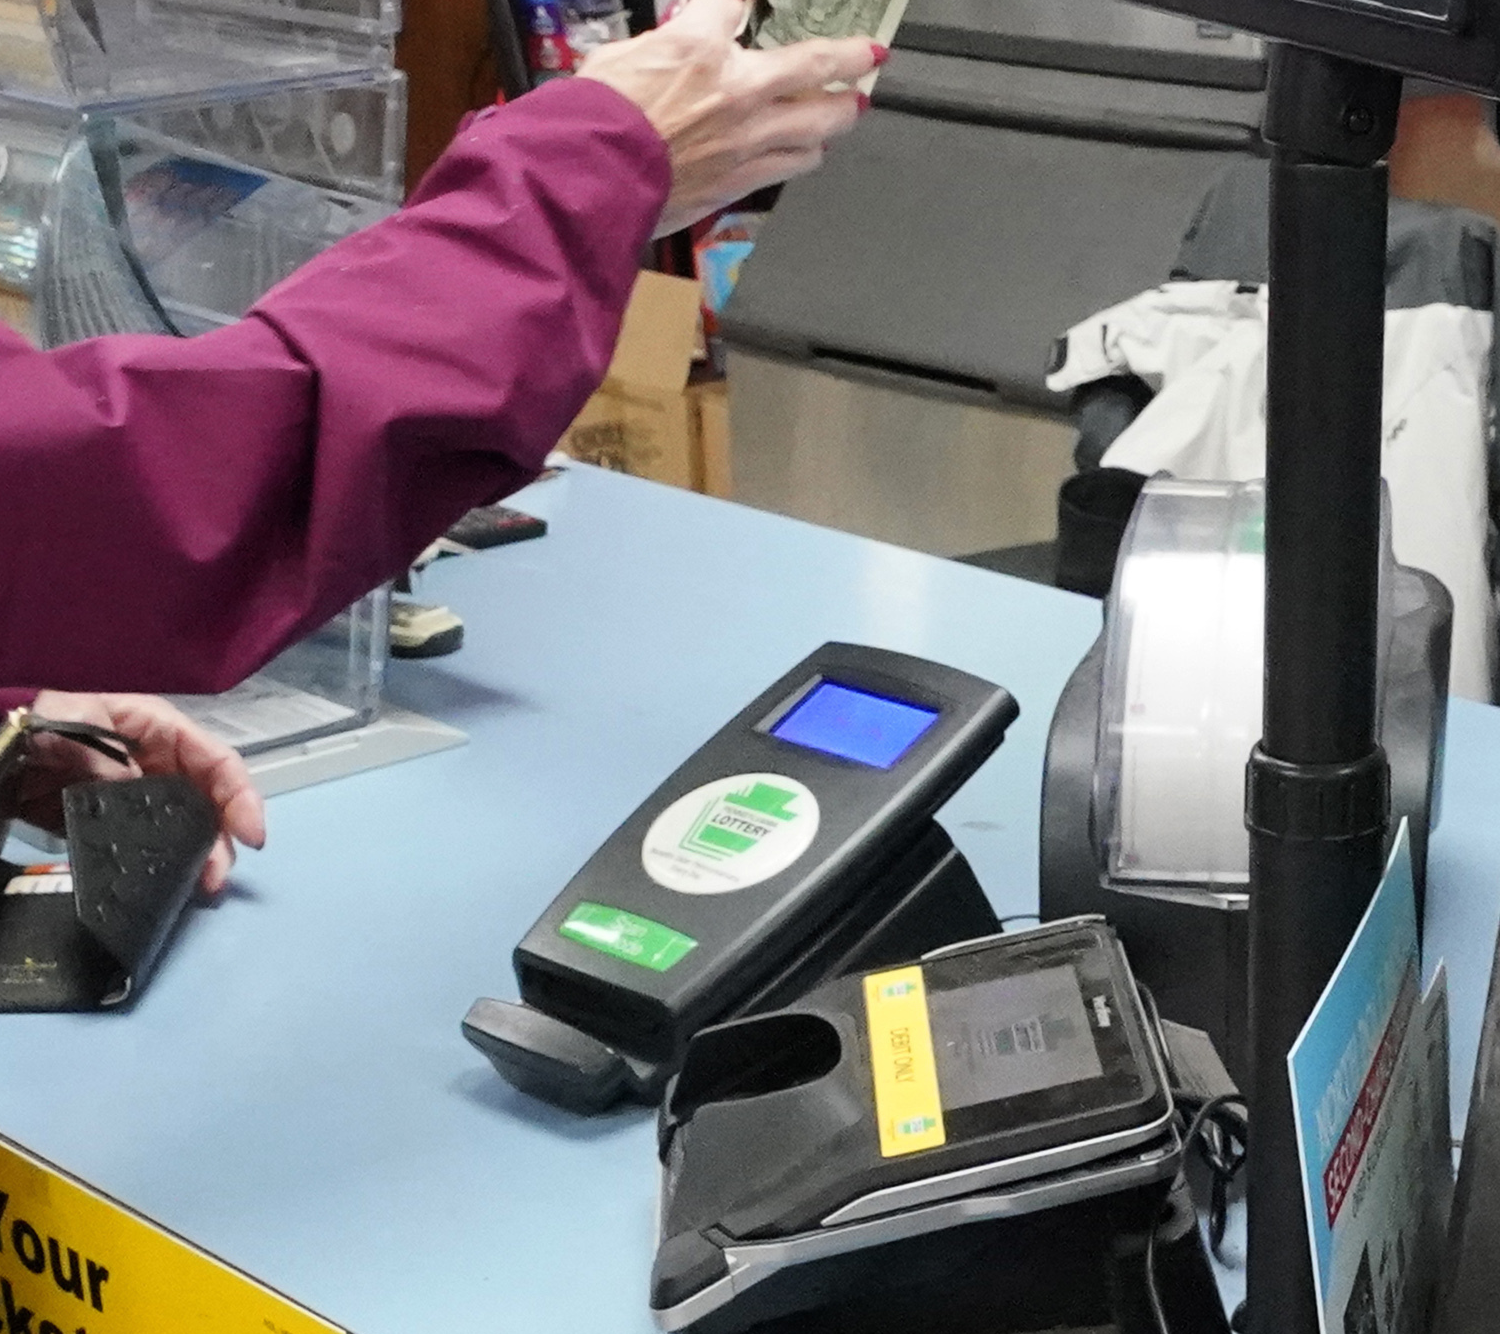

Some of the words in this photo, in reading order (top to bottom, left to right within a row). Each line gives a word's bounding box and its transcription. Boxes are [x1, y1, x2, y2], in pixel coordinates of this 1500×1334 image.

[711, 813, 771, 838] LOTTERY
[890, 1027, 911, 1055] DEBIT
[894, 1055, 916, 1084] ONLY
